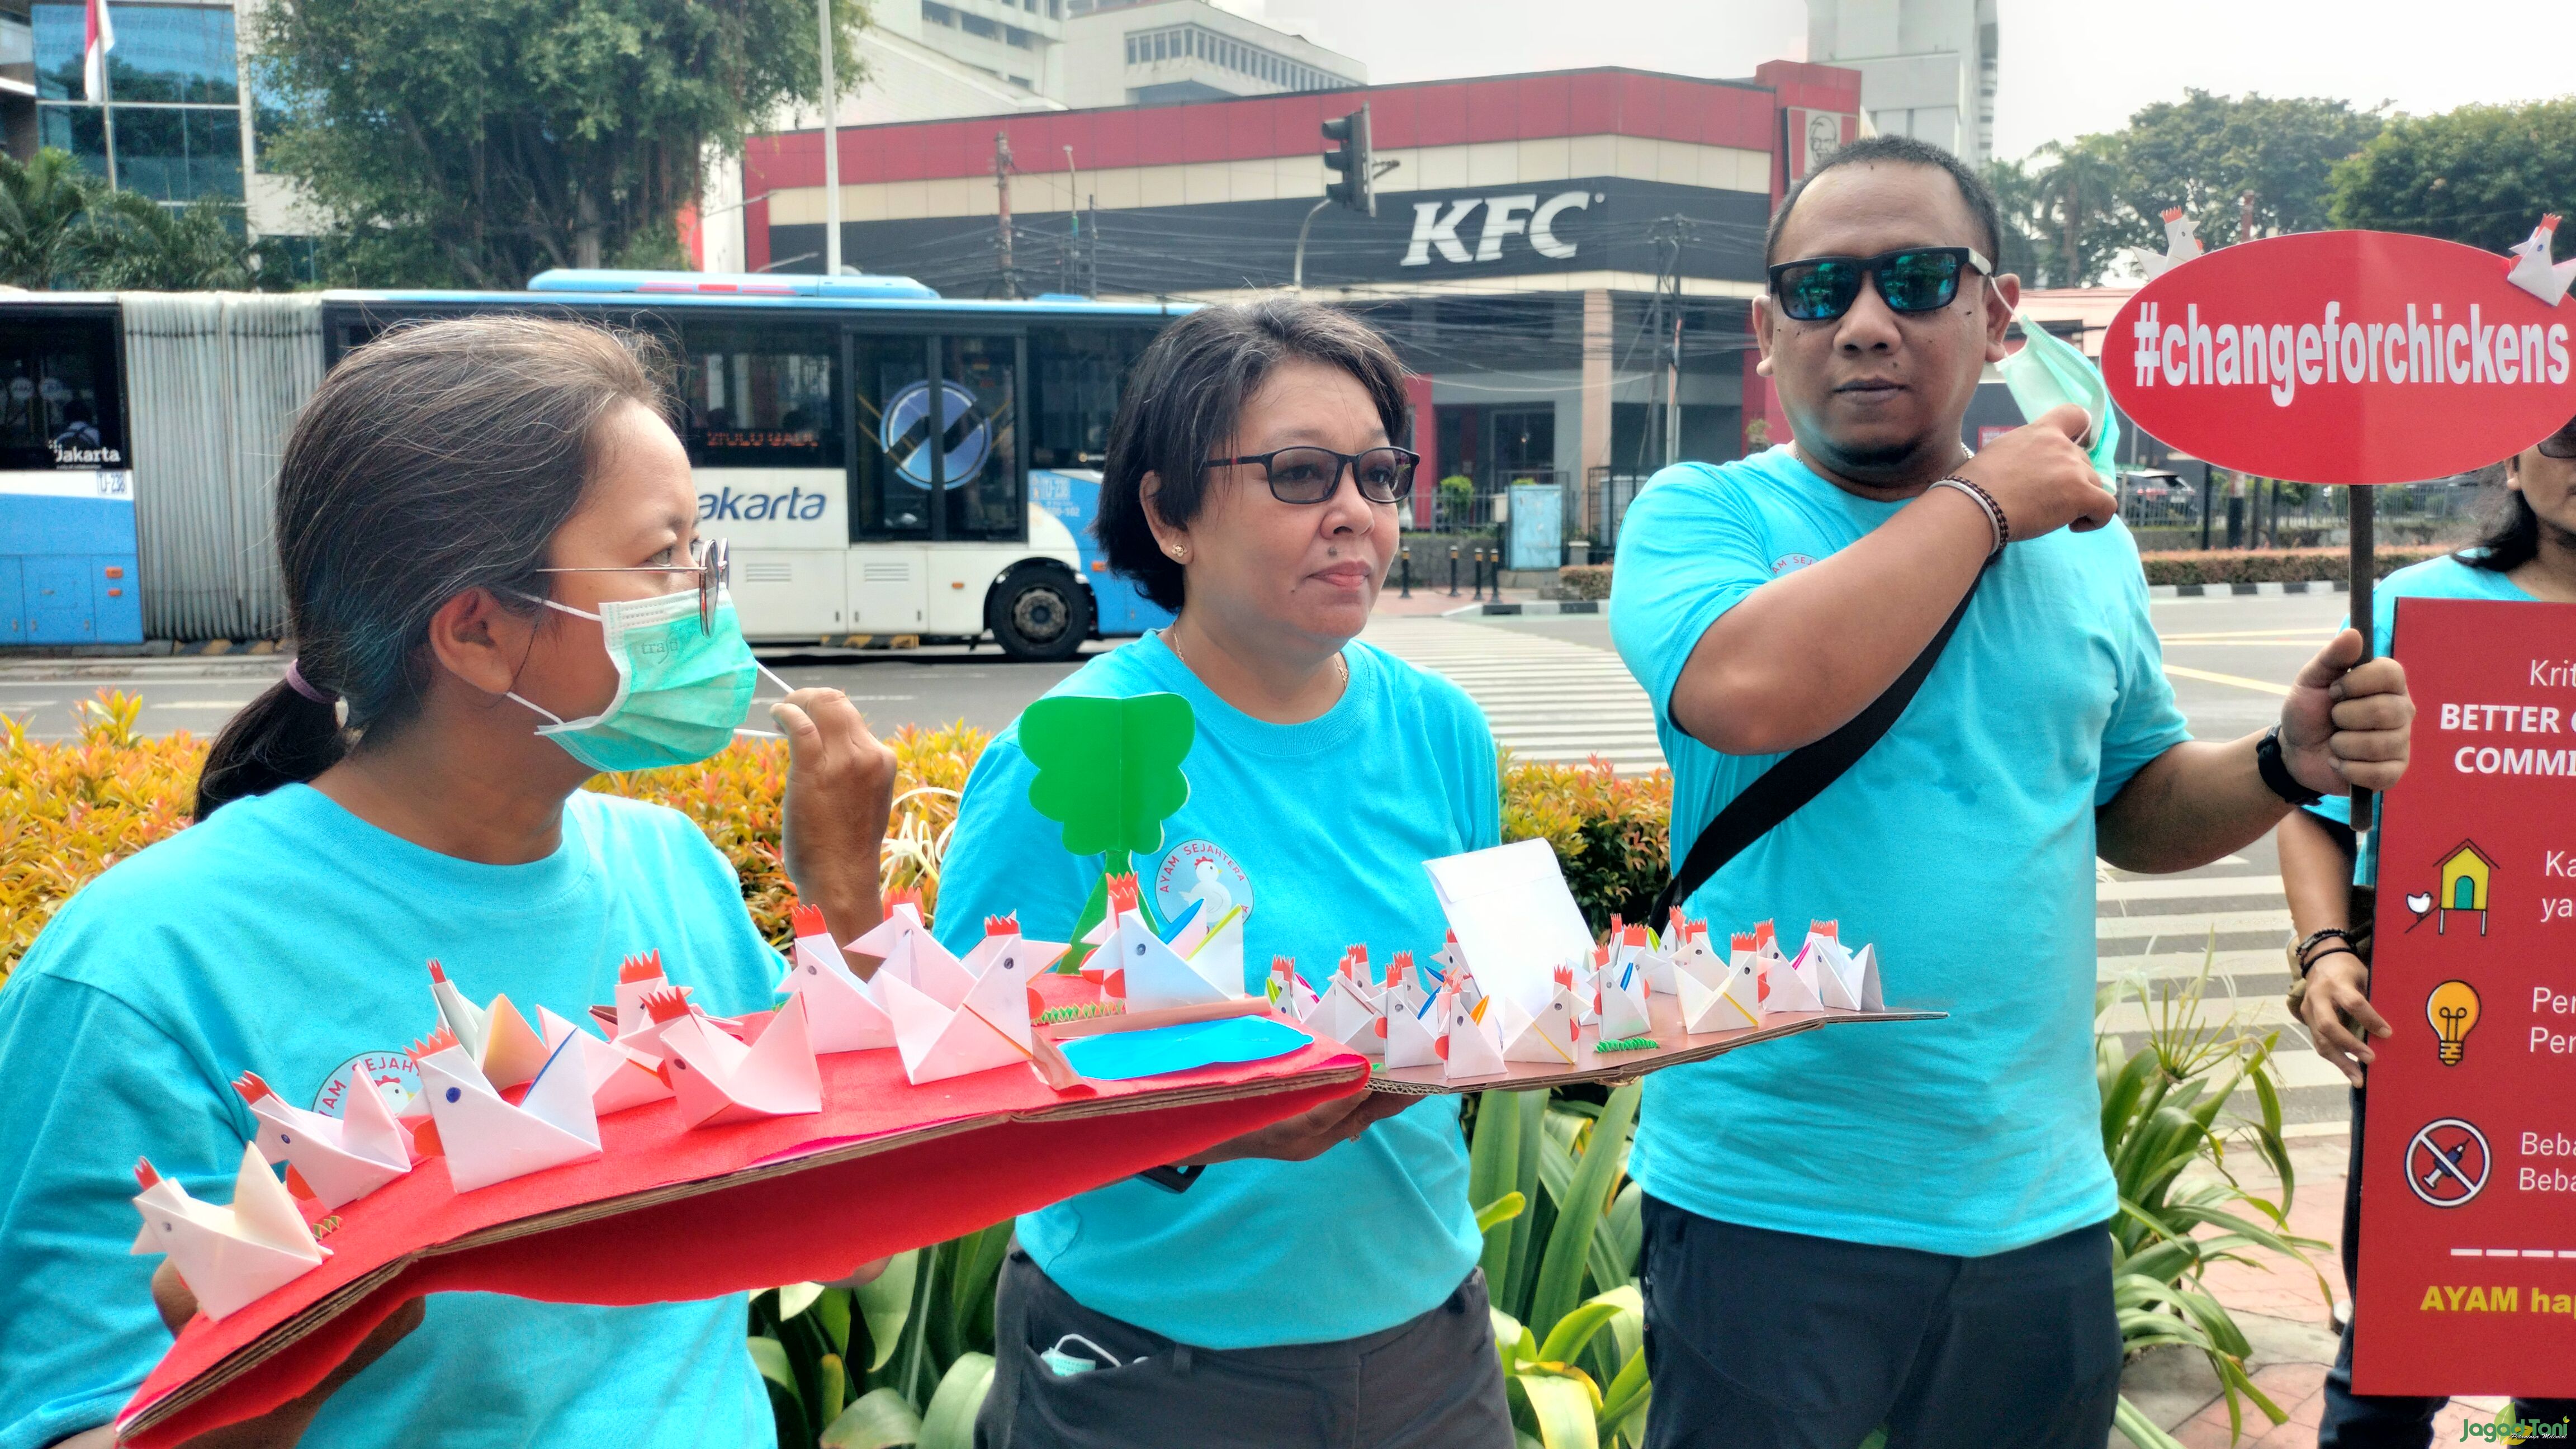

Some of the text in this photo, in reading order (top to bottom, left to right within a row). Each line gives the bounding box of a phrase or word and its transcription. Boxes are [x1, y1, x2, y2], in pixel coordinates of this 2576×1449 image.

[1400, 191, 1590, 266] KFC
[2134, 301, 2570, 407] #changeforchickens
[2440, 703, 2560, 733] BETTER
[1160, 844, 1245, 893] AYAM SEJAHTERA
[2521, 1131, 2576, 1156] Beb
[2420, 1286, 2576, 1319] AYAM ha
